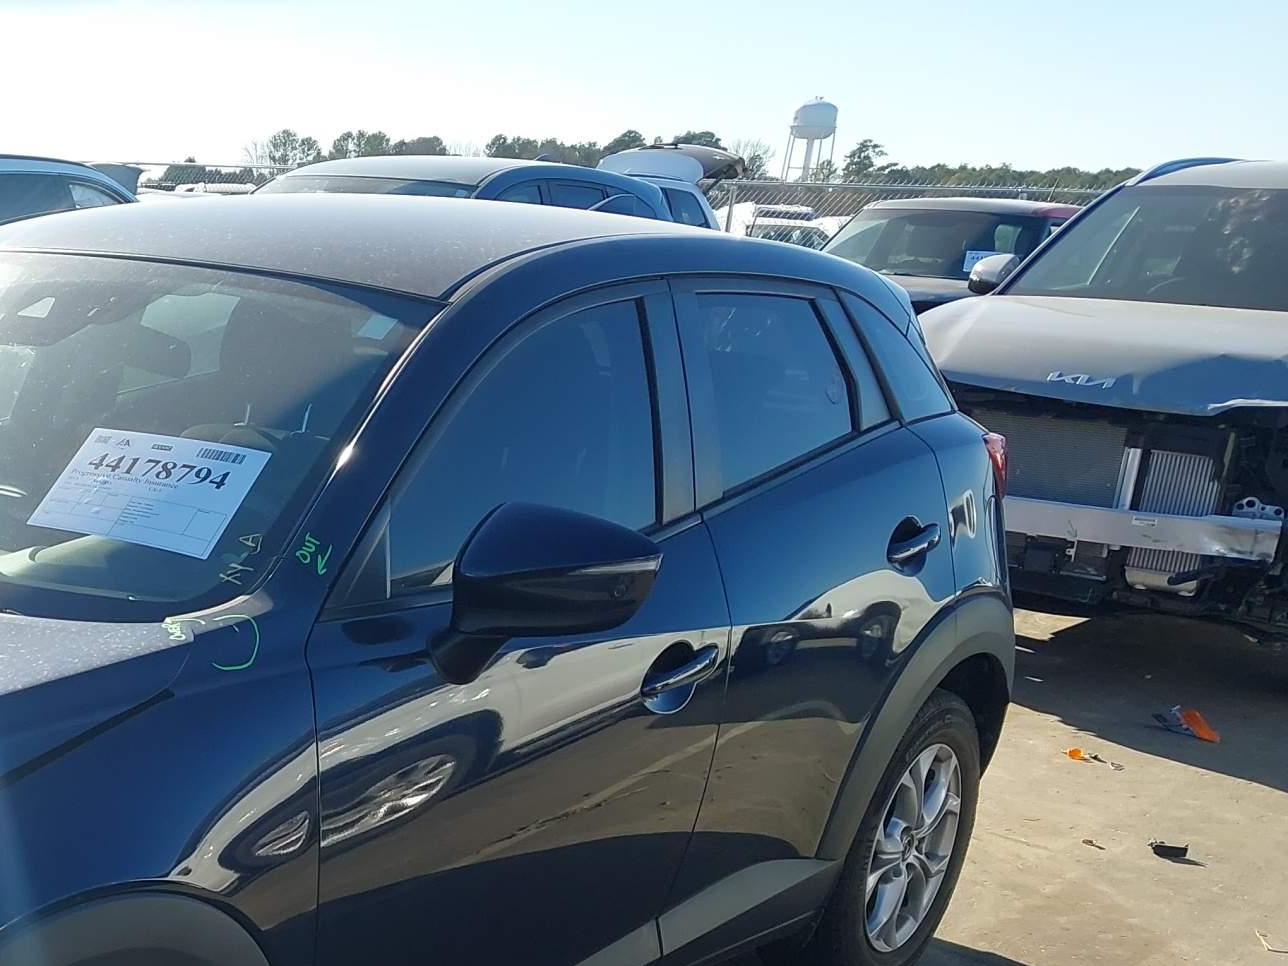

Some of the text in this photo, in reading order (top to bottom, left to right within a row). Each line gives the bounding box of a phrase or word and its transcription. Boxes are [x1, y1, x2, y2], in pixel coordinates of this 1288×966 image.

[88, 453, 231, 490] 44178794
[144, 478, 179, 489] Insurance
[296, 532, 320, 563] OUT
